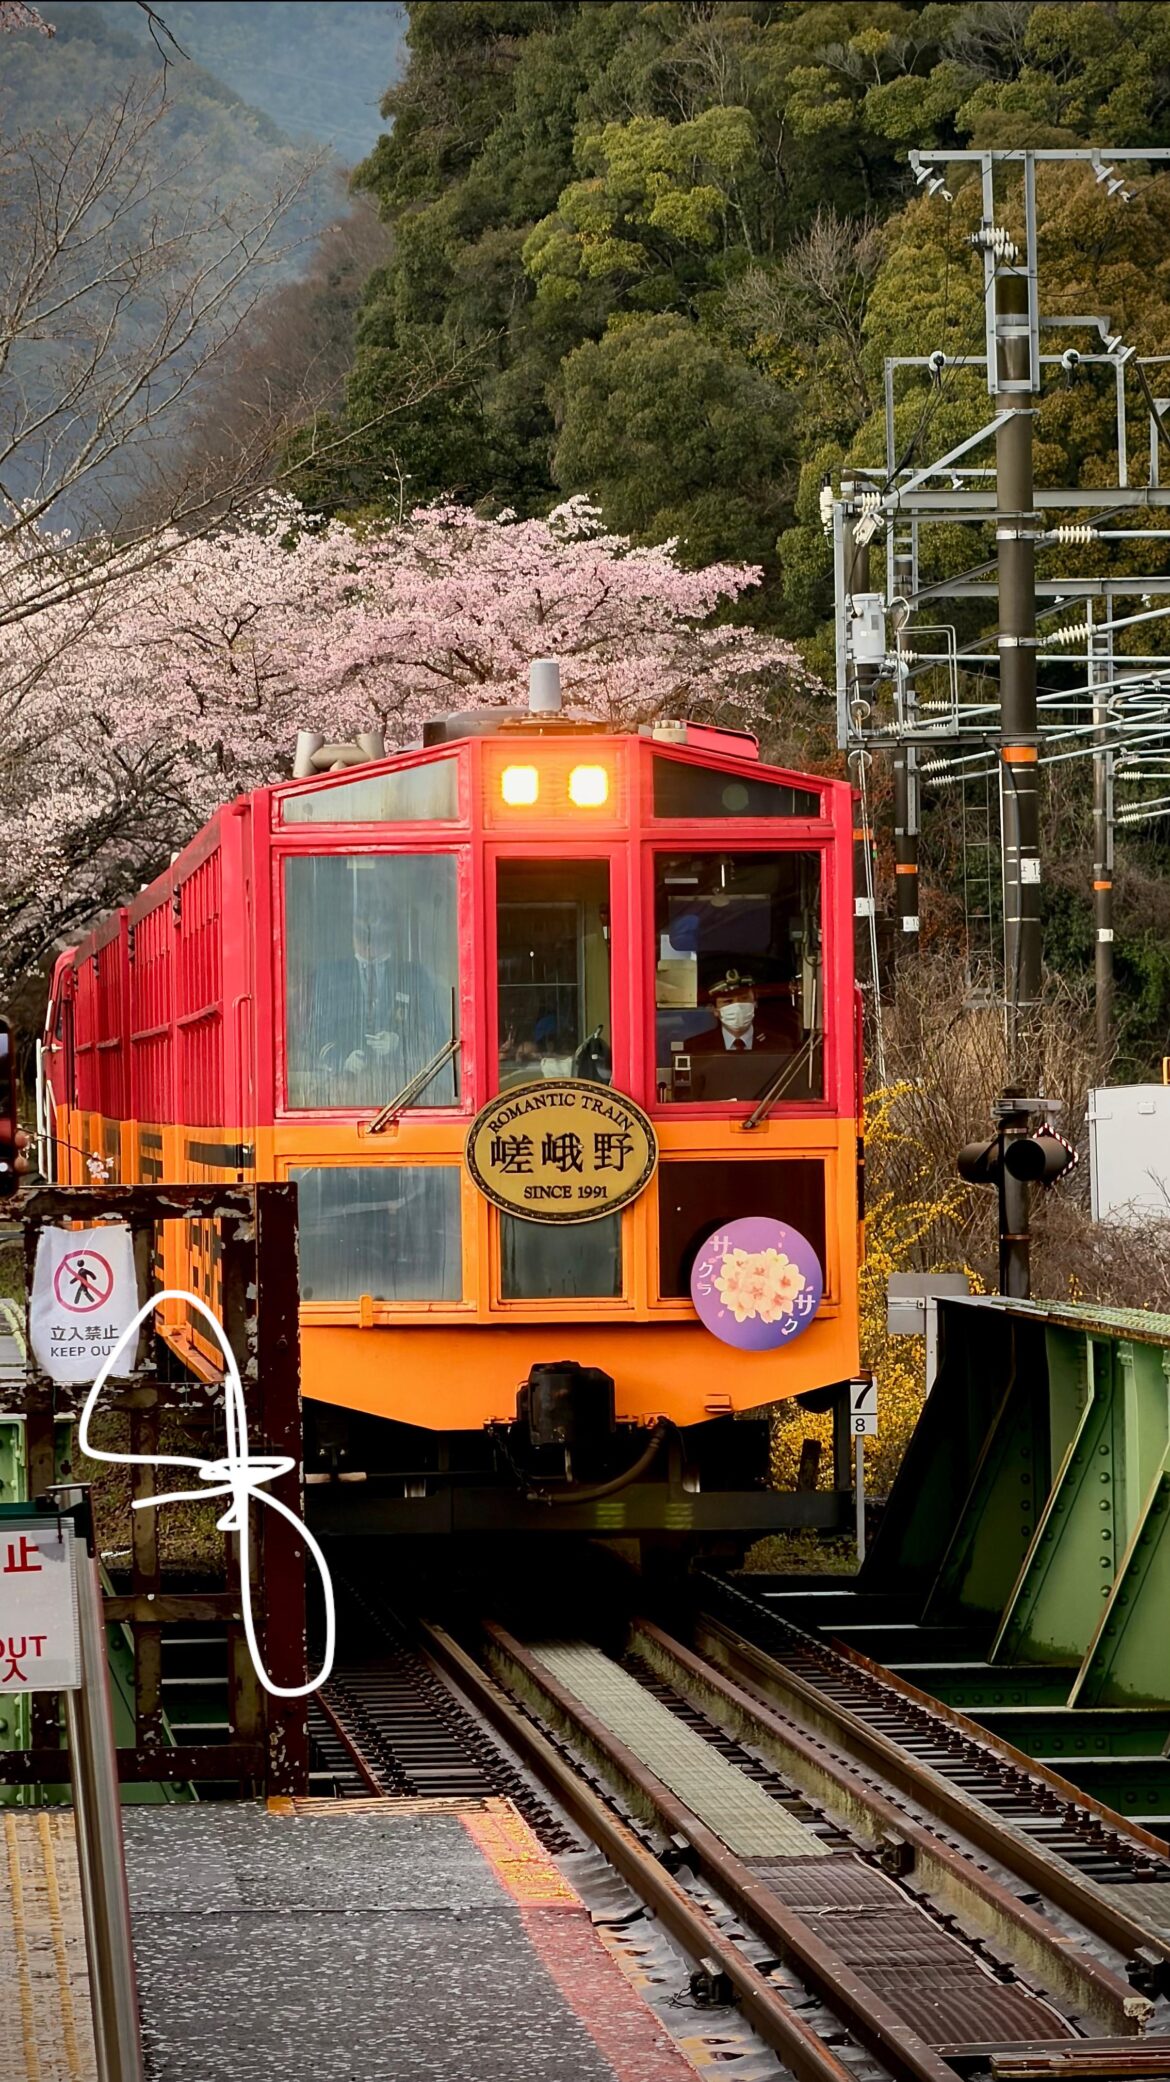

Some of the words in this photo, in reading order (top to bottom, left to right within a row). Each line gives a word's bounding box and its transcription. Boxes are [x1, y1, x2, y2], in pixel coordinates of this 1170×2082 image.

[487, 1093, 576, 1134] ROMANTIC
[581, 1095, 635, 1132] TRAIN
[489, 1131, 635, 1174] 嵯峨野
[523, 1185, 573, 1199] SINCE
[578, 1185, 608, 1199] 1991
[50, 1324, 120, 1341] 立入禁止
[50, 1346, 86, 1357] KEEP
[850, 1380, 873, 1410] 7
[855, 1418, 866, 1433] 8
[0, 1635, 47, 1659] UT
